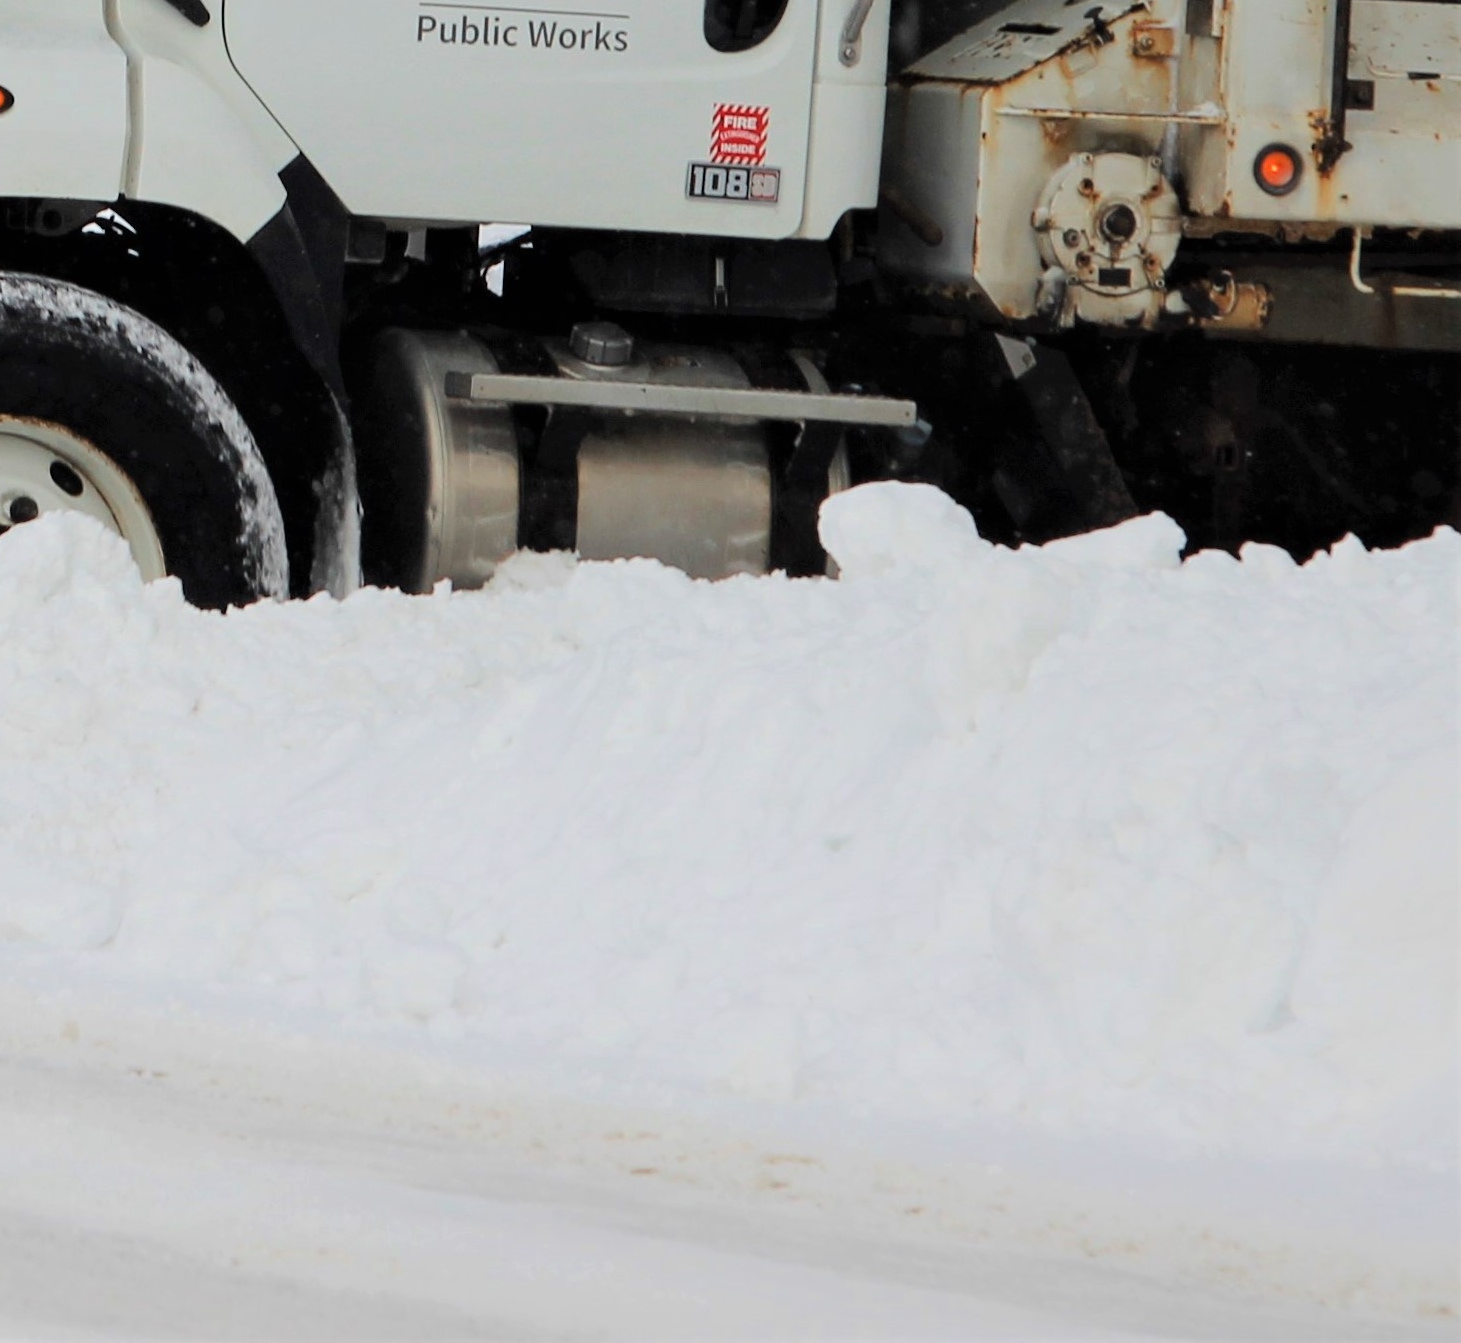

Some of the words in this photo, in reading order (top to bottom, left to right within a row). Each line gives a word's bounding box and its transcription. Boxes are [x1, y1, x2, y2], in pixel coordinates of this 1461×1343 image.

[417, 15, 518, 46] Public
[528, 20, 628, 52] Works
[723, 115, 758, 130] FIRE
[720, 143, 757, 155] INSIDE
